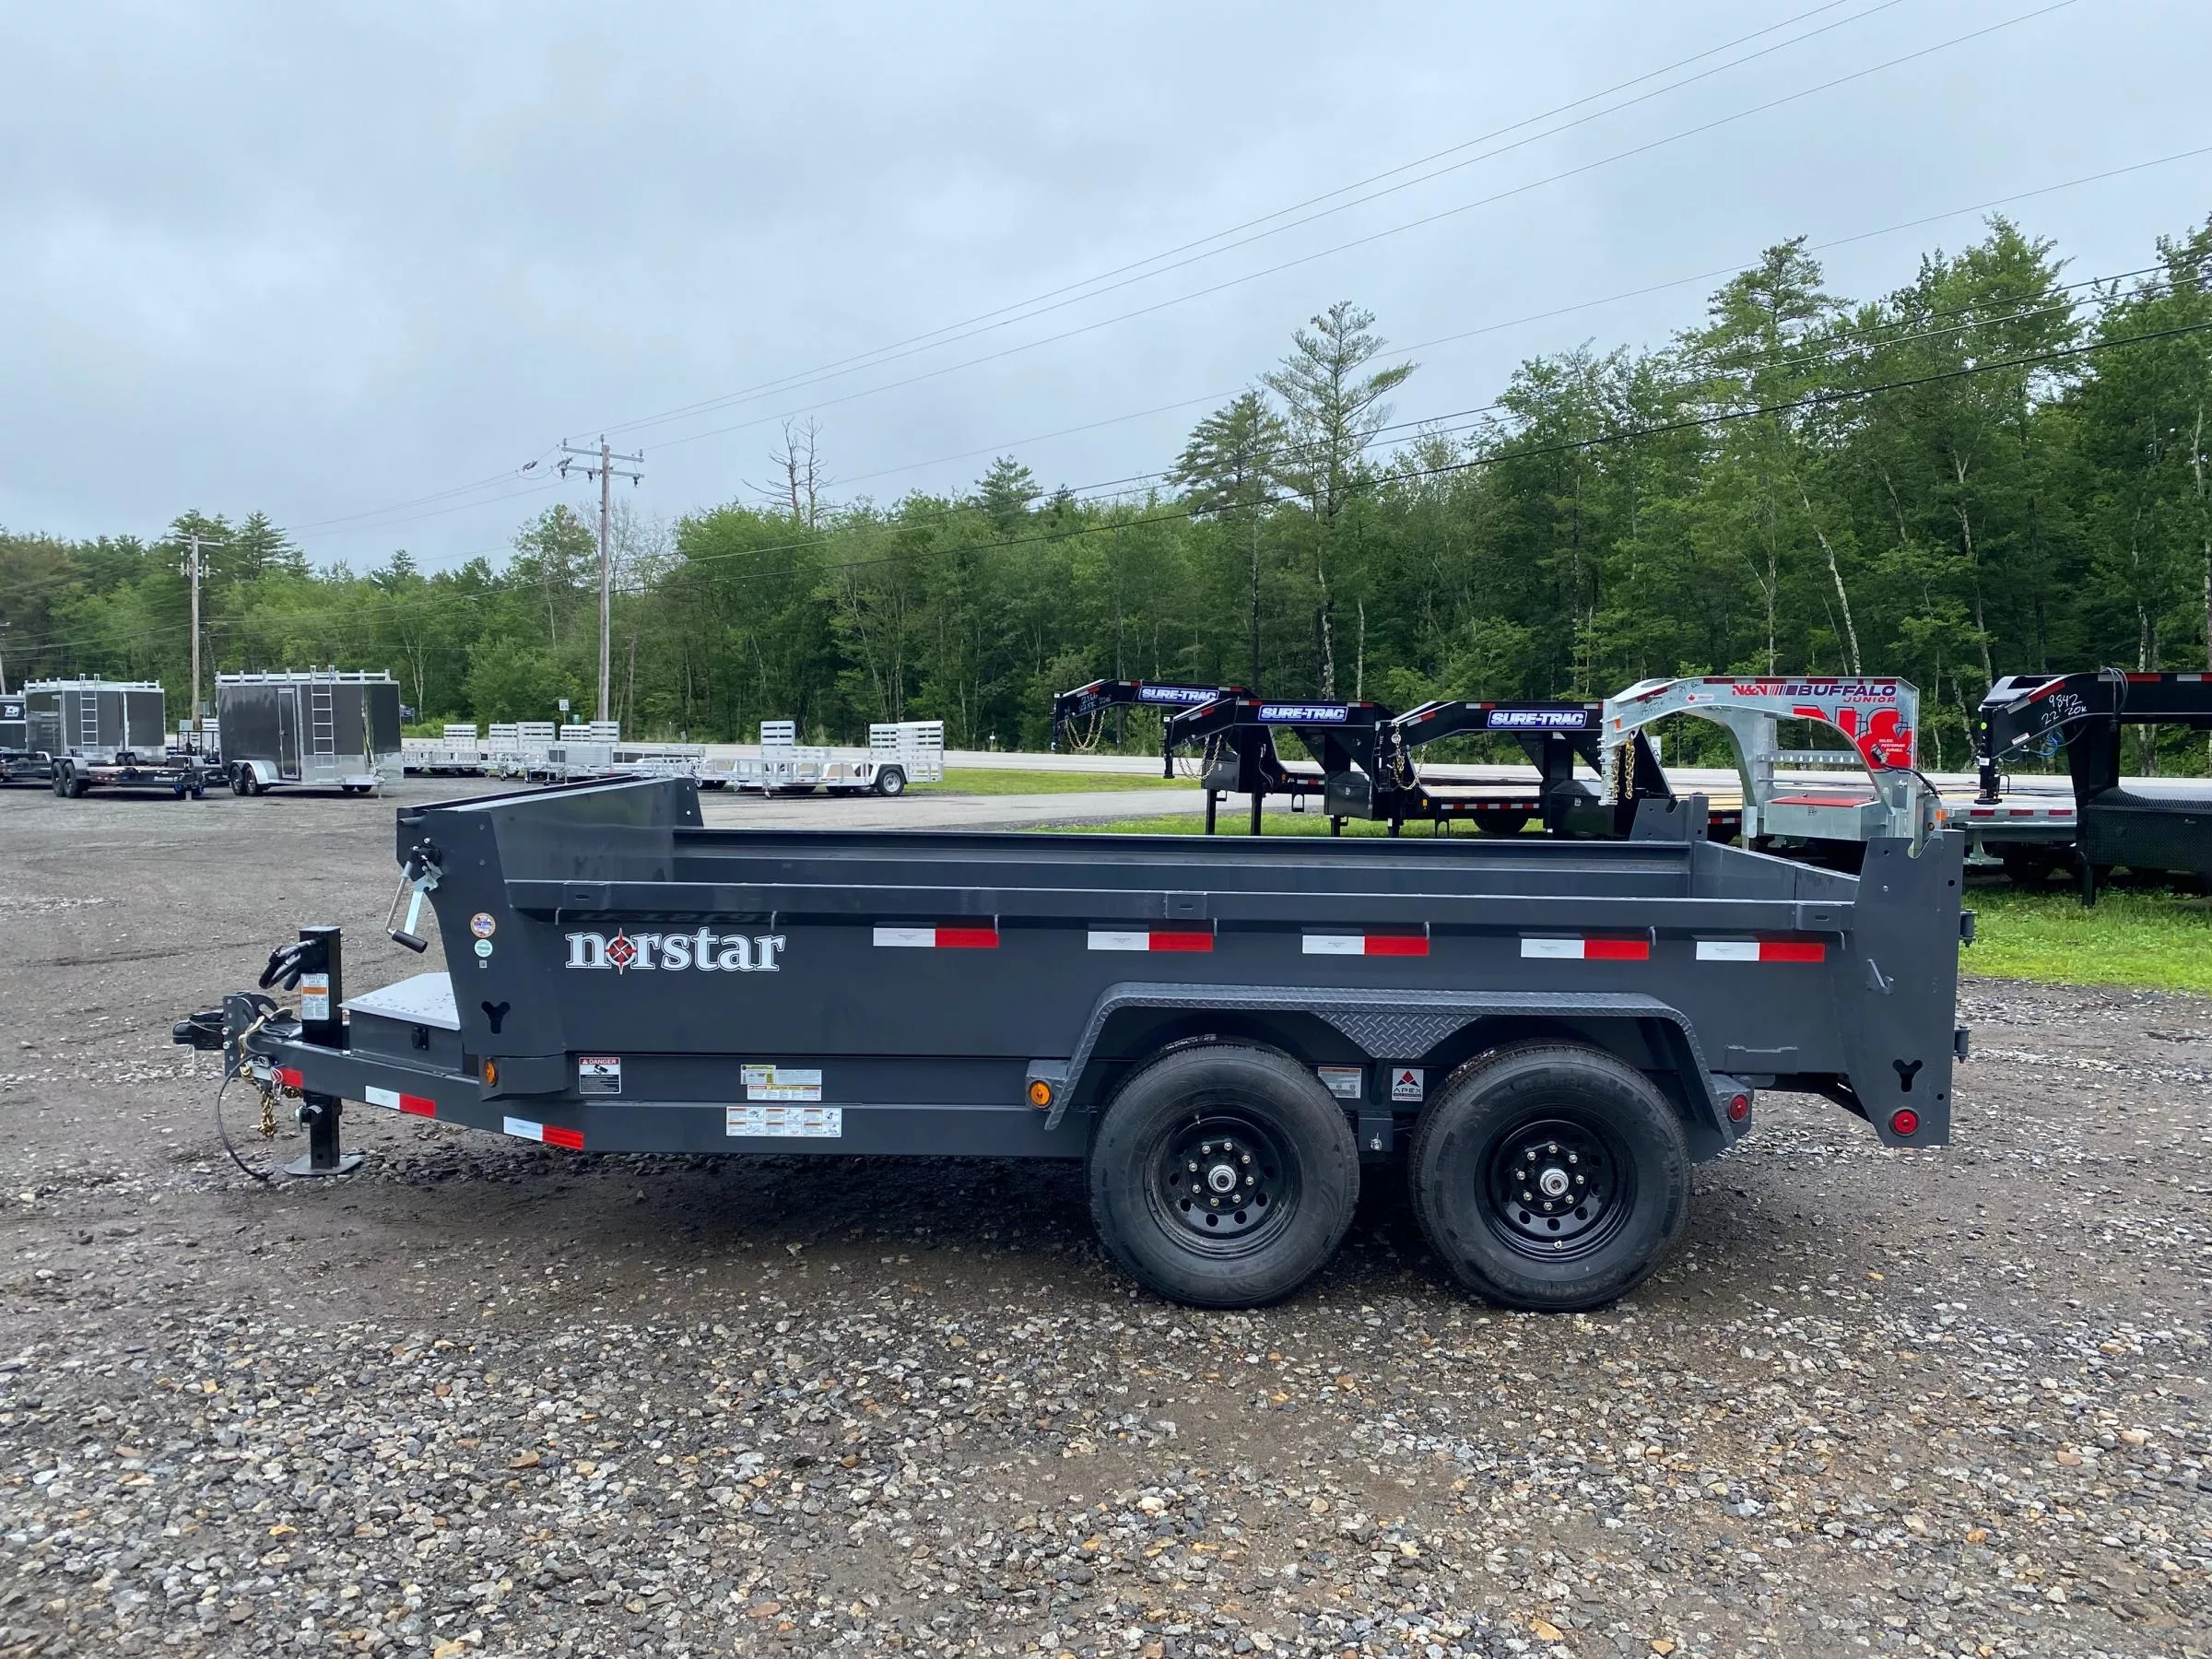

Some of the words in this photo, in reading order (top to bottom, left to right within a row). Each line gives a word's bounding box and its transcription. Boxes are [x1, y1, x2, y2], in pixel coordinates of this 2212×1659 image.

[1141, 688, 1218, 701] SURE-TRAC
[1797, 685, 1897, 697] BUFFALO
[2048, 693, 2083, 708] 9842
[1261, 707, 1345, 720] SURE-TRAC
[1490, 712, 1584, 725] SURE-TRAC
[565, 926, 787, 975] norstar
